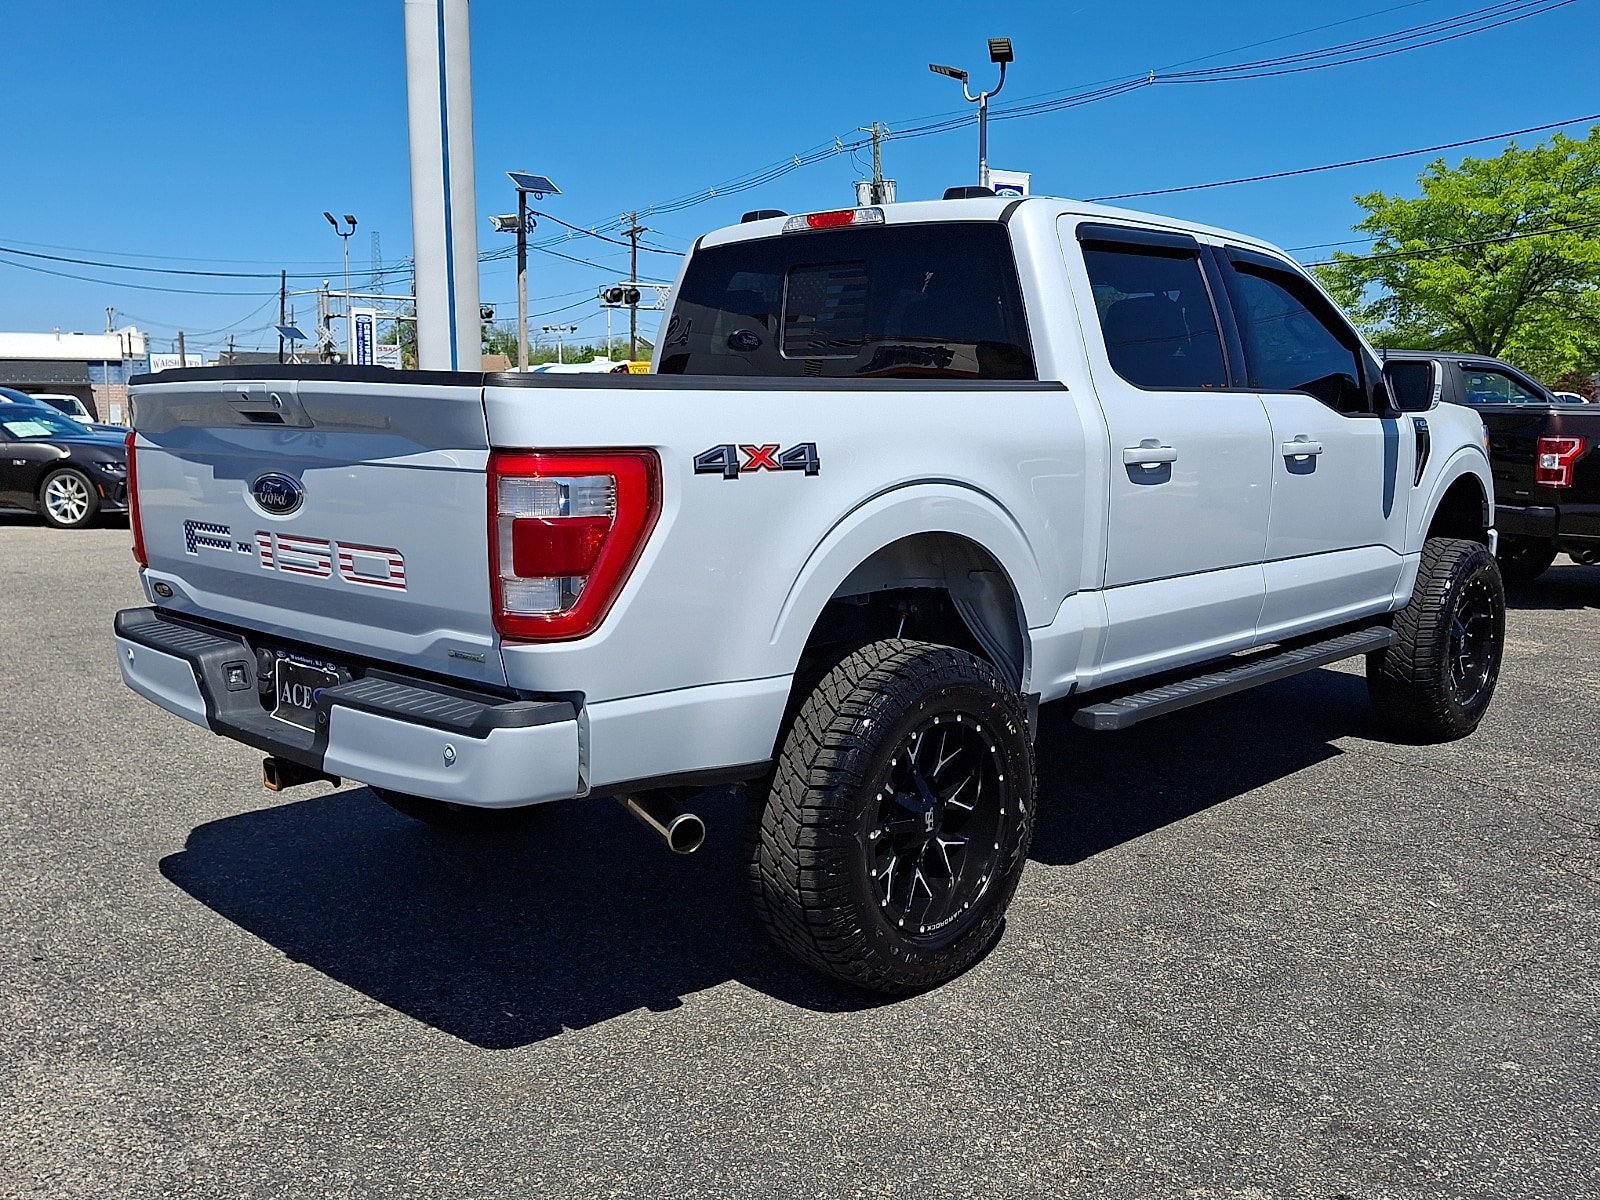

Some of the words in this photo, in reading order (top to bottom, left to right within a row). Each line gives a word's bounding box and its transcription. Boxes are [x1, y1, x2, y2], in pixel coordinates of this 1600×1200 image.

[260, 481, 288, 506] Ford
[183, 518, 408, 593] F-150
[281, 681, 313, 710] ACE
[926, 907, 963, 932] HARDROCK
